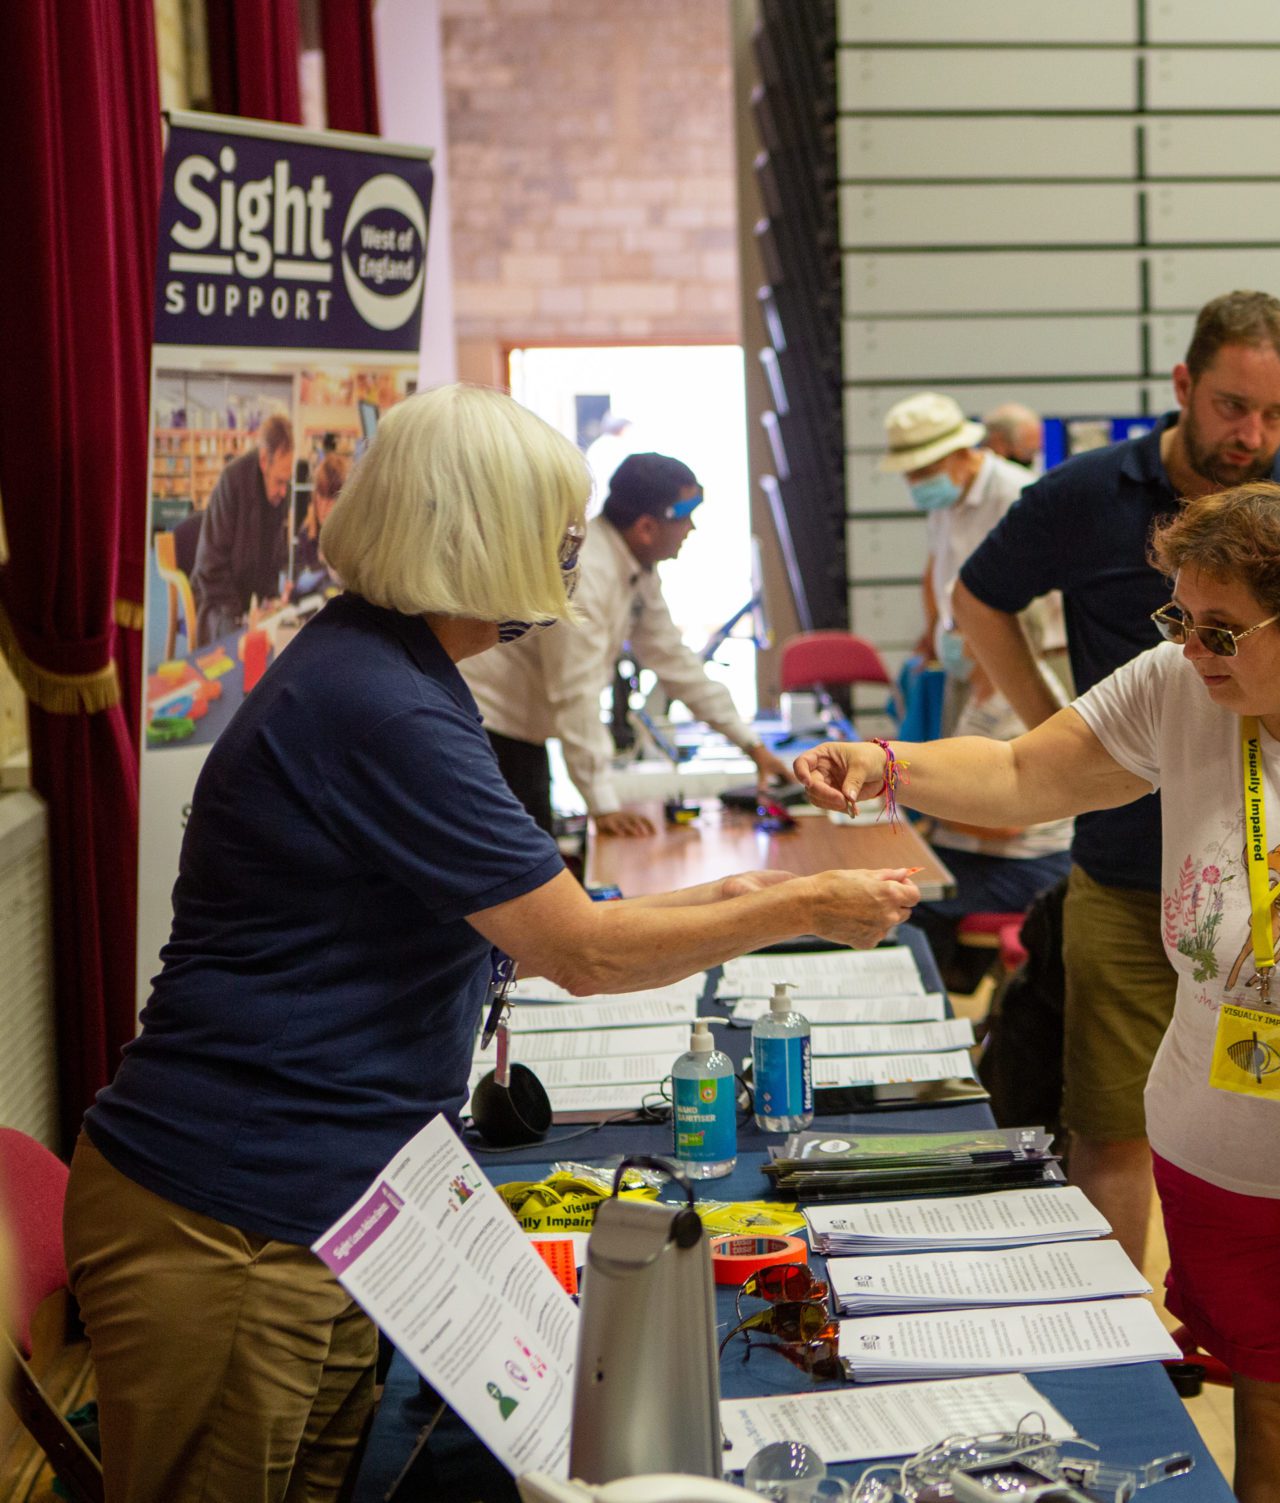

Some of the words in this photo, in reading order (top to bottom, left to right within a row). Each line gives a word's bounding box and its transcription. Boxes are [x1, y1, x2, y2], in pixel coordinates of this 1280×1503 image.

[170, 146, 333, 279] Sight
[361, 224, 396, 251] West
[397, 227, 413, 252] of
[360, 254, 414, 284] England
[164, 281, 332, 321] SUPPORT
[1248, 739, 1260, 793] Visually
[1250, 799, 1264, 861] Impaired
[1224, 1007, 1263, 1022] VISUALLY
